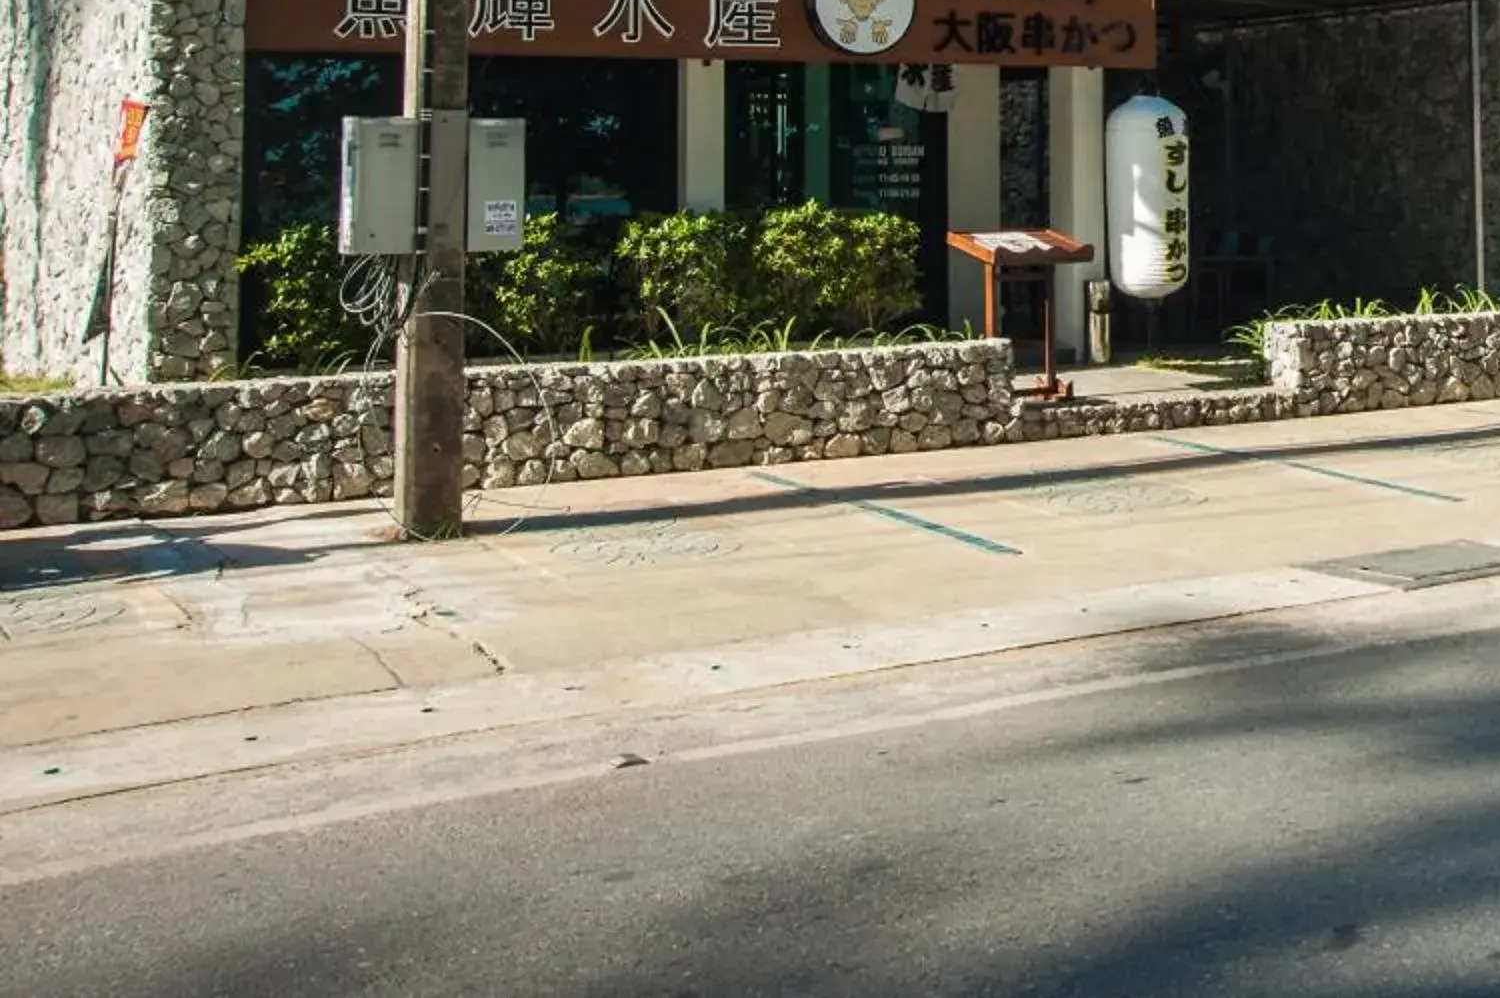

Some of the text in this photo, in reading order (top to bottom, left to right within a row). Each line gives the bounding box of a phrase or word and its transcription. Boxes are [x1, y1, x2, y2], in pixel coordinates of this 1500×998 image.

[932, 10, 1138, 54] 大阪串かつ
